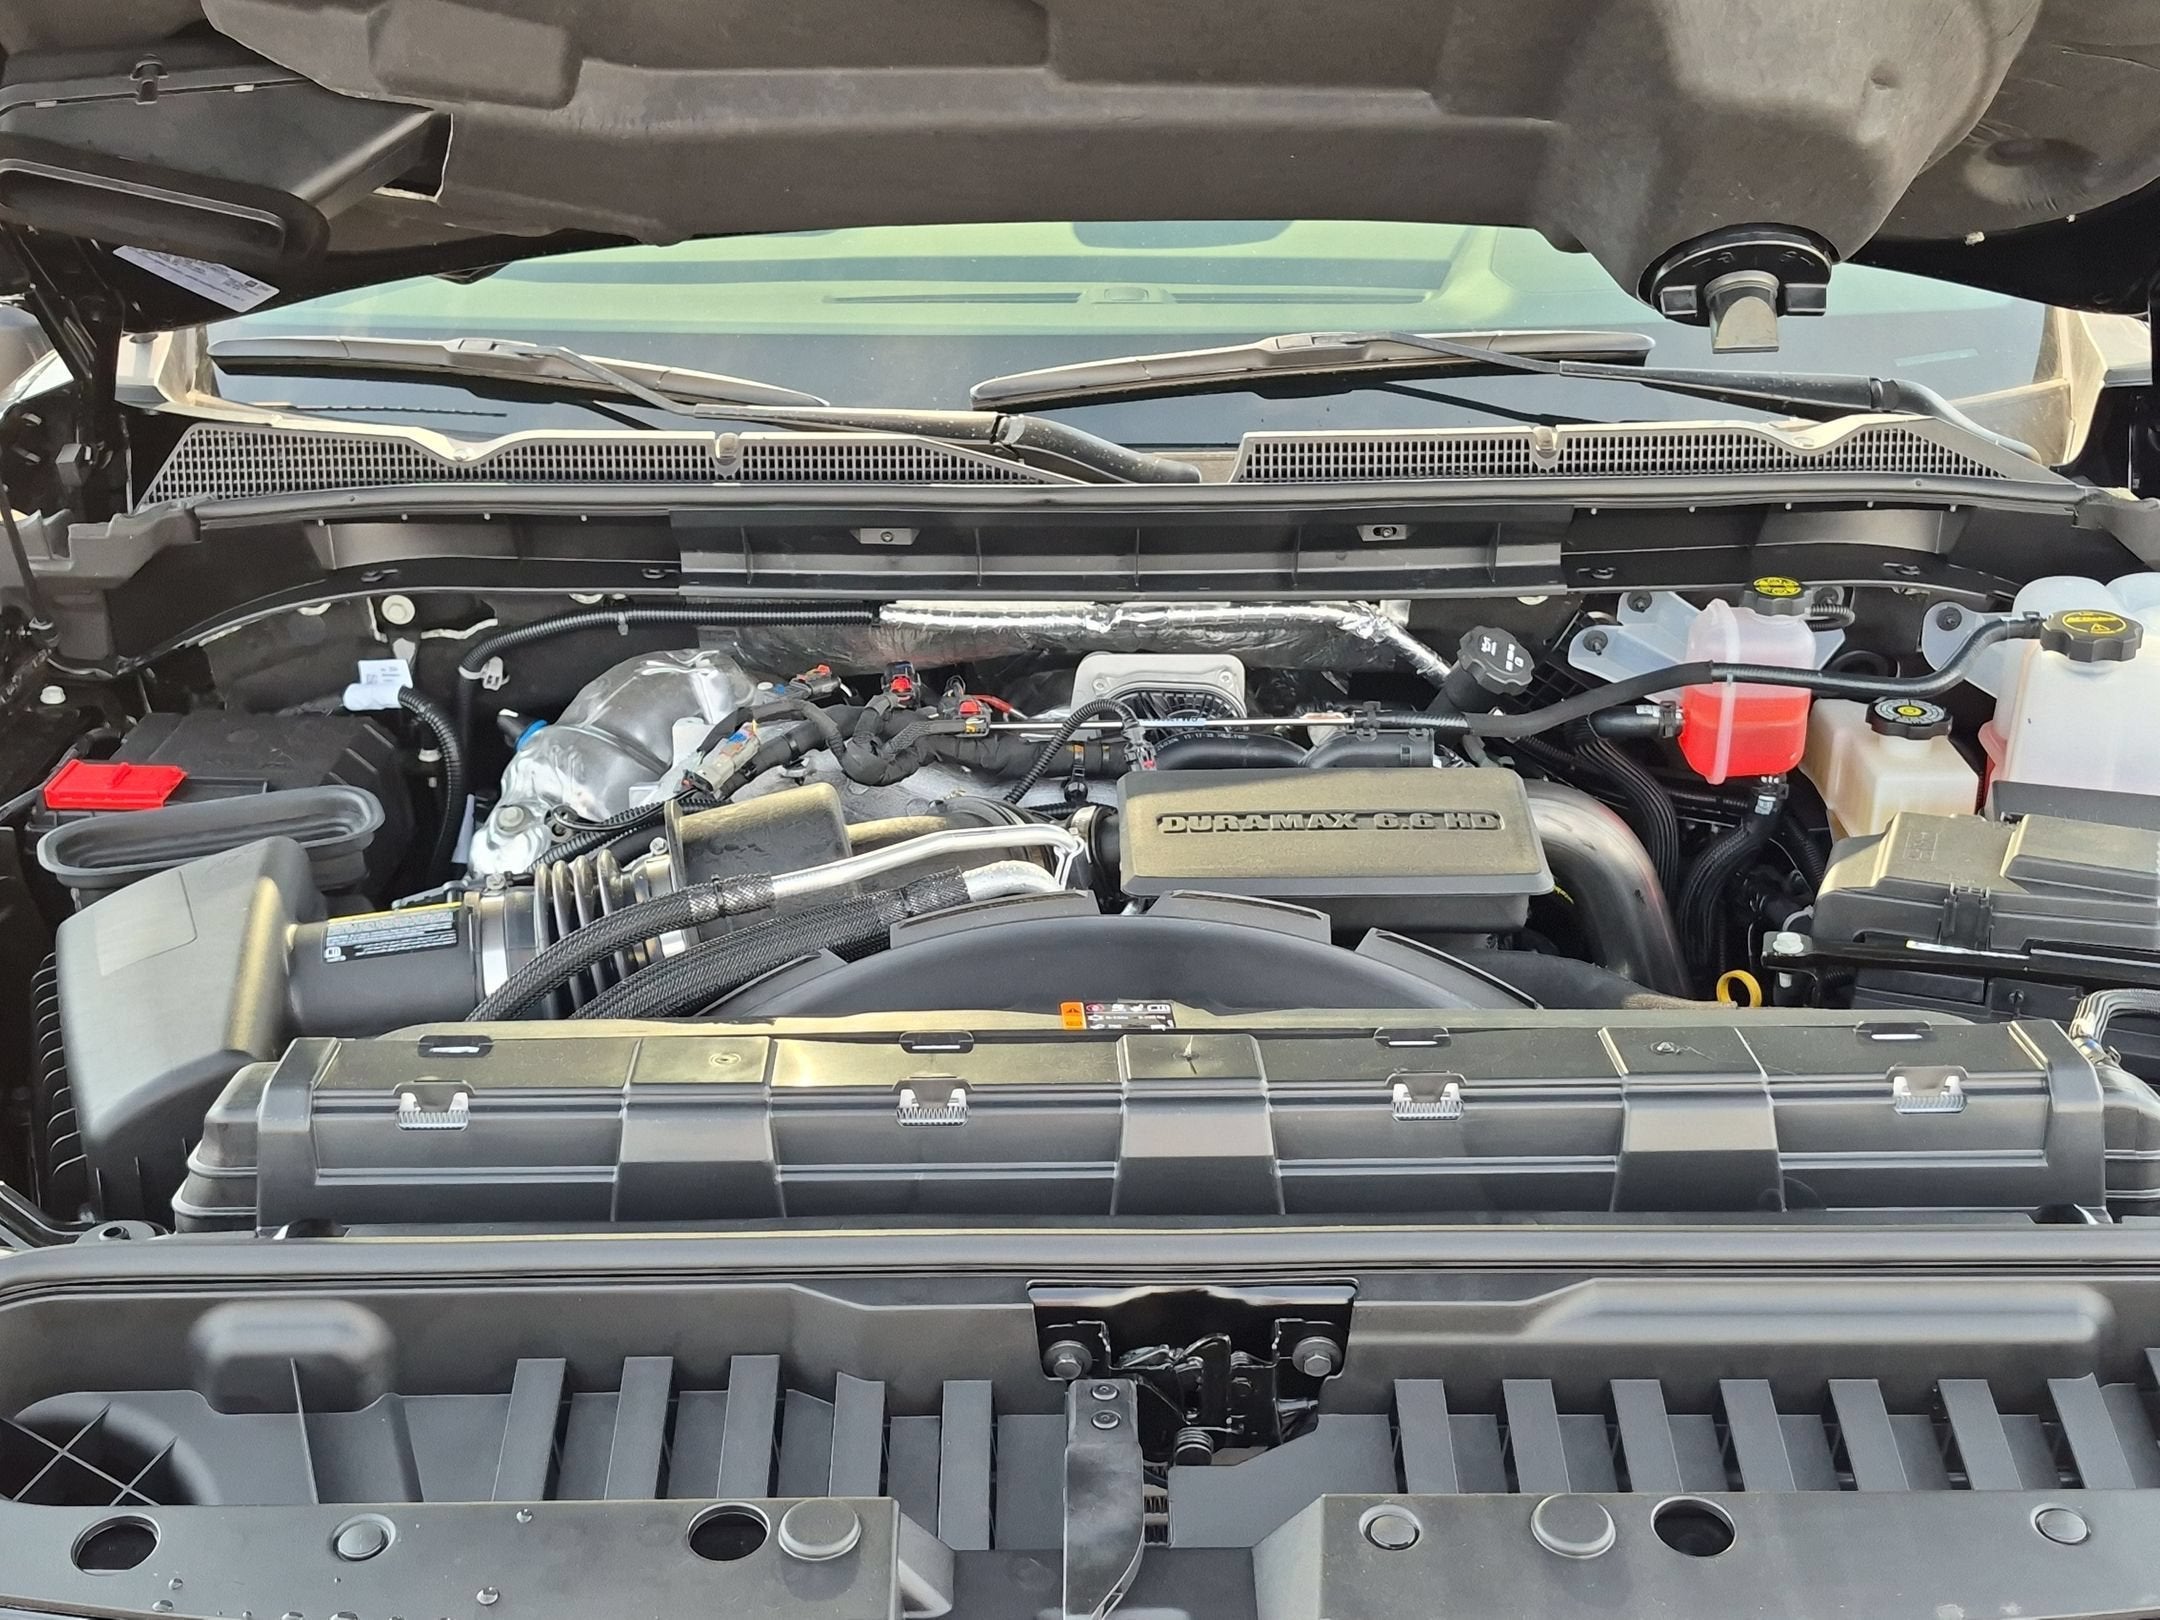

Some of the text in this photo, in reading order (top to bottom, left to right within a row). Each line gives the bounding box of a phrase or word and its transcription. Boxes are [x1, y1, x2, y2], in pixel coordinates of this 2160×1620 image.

[1161, 812, 1501, 833] DURAMAX 6.6 HD
